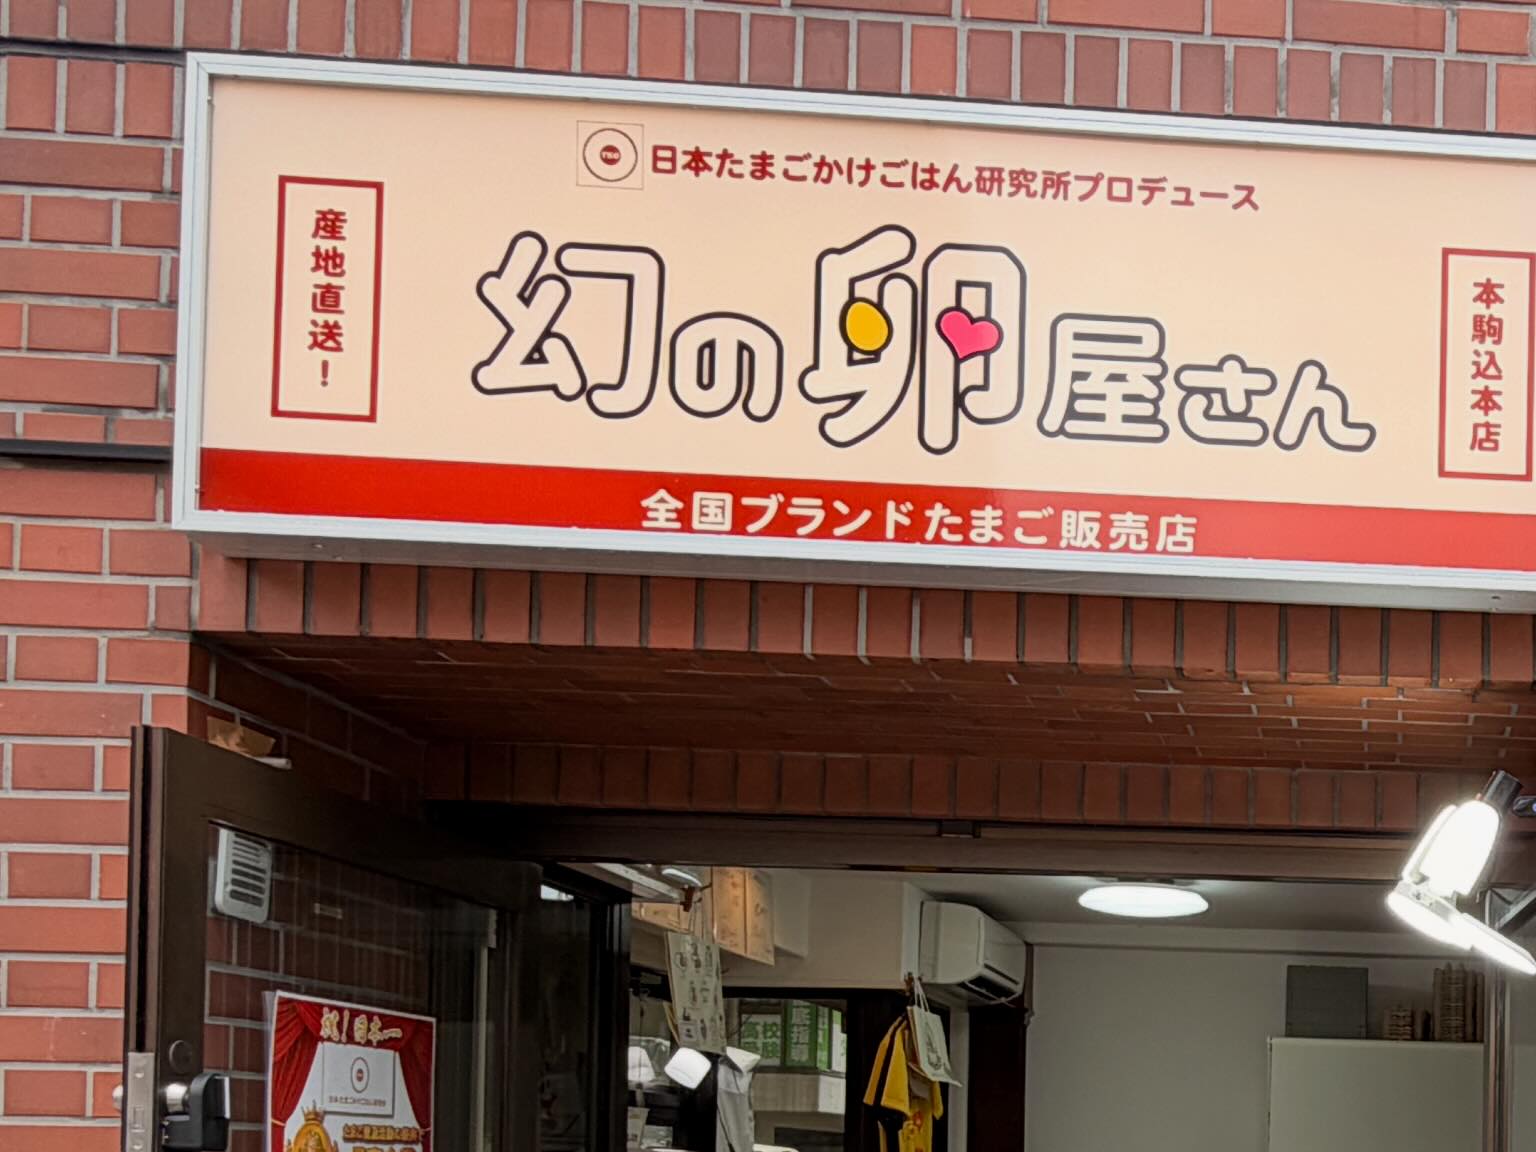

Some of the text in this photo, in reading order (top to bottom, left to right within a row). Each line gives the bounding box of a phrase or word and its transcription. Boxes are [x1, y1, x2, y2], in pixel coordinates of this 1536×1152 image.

[651, 144, 1260, 213] 日本たまごかけごはん研究所プロデュース
[471, 224, 1377, 456] 幻の卵屋さん
[1468, 277, 1506, 454] 本駒込本店
[639, 488, 1199, 556] 全国ブランドたまご販売店
